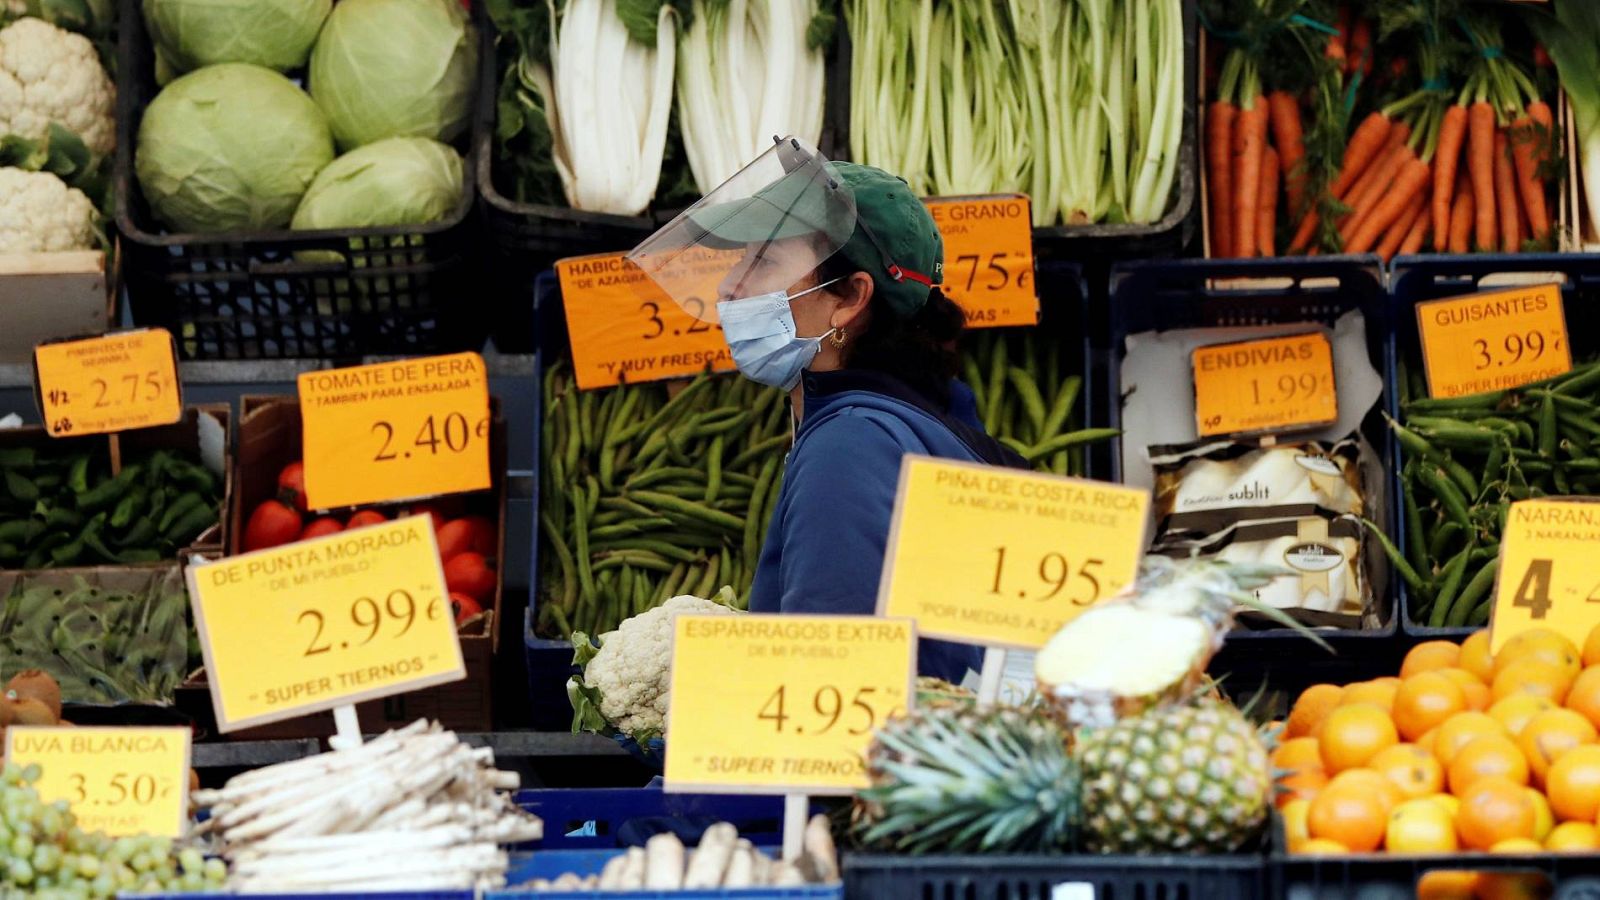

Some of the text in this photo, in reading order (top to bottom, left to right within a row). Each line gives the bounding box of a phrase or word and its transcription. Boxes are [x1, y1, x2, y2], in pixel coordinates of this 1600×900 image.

[949, 203, 1021, 221] GRANO
[640, 297, 723, 339] 3.2
[1435, 294, 1548, 326] GUISANTES
[621, 356, 657, 373] MUY
[1201, 342, 1313, 371] ENDIVIAS
[307, 358, 477, 393] TOMATE DE PERA
[371, 386, 404, 400] PARA
[936, 469, 1141, 512] PIÑA DE COSTA RICA
[1228, 480, 1270, 501] sublit
[970, 497, 1019, 513] MEJOR
[1024, 503, 1034, 514] Y
[1037, 505, 1068, 520] MAS
[1070, 509, 1118, 528] DULCE
[1516, 508, 1600, 527] NARAN
[1536, 530, 1600, 541] NARANJA
[212, 527, 421, 587] DE PUNTA MORADA
[293, 573, 309, 586] MI
[313, 560, 371, 581] PUEBLO
[1512, 559, 1553, 619] 4
[961, 608, 1021, 629] MEDIAS
[1025, 617, 1038, 630] A
[836, 623, 907, 642] EXTRA
[771, 645, 787, 657] MI
[790, 645, 849, 659] PUEBLO
[265, 656, 424, 705] SUPER TIERNOS
[14, 735, 169, 753] UVA BLANCA
[707, 756, 774, 776] SUPER
